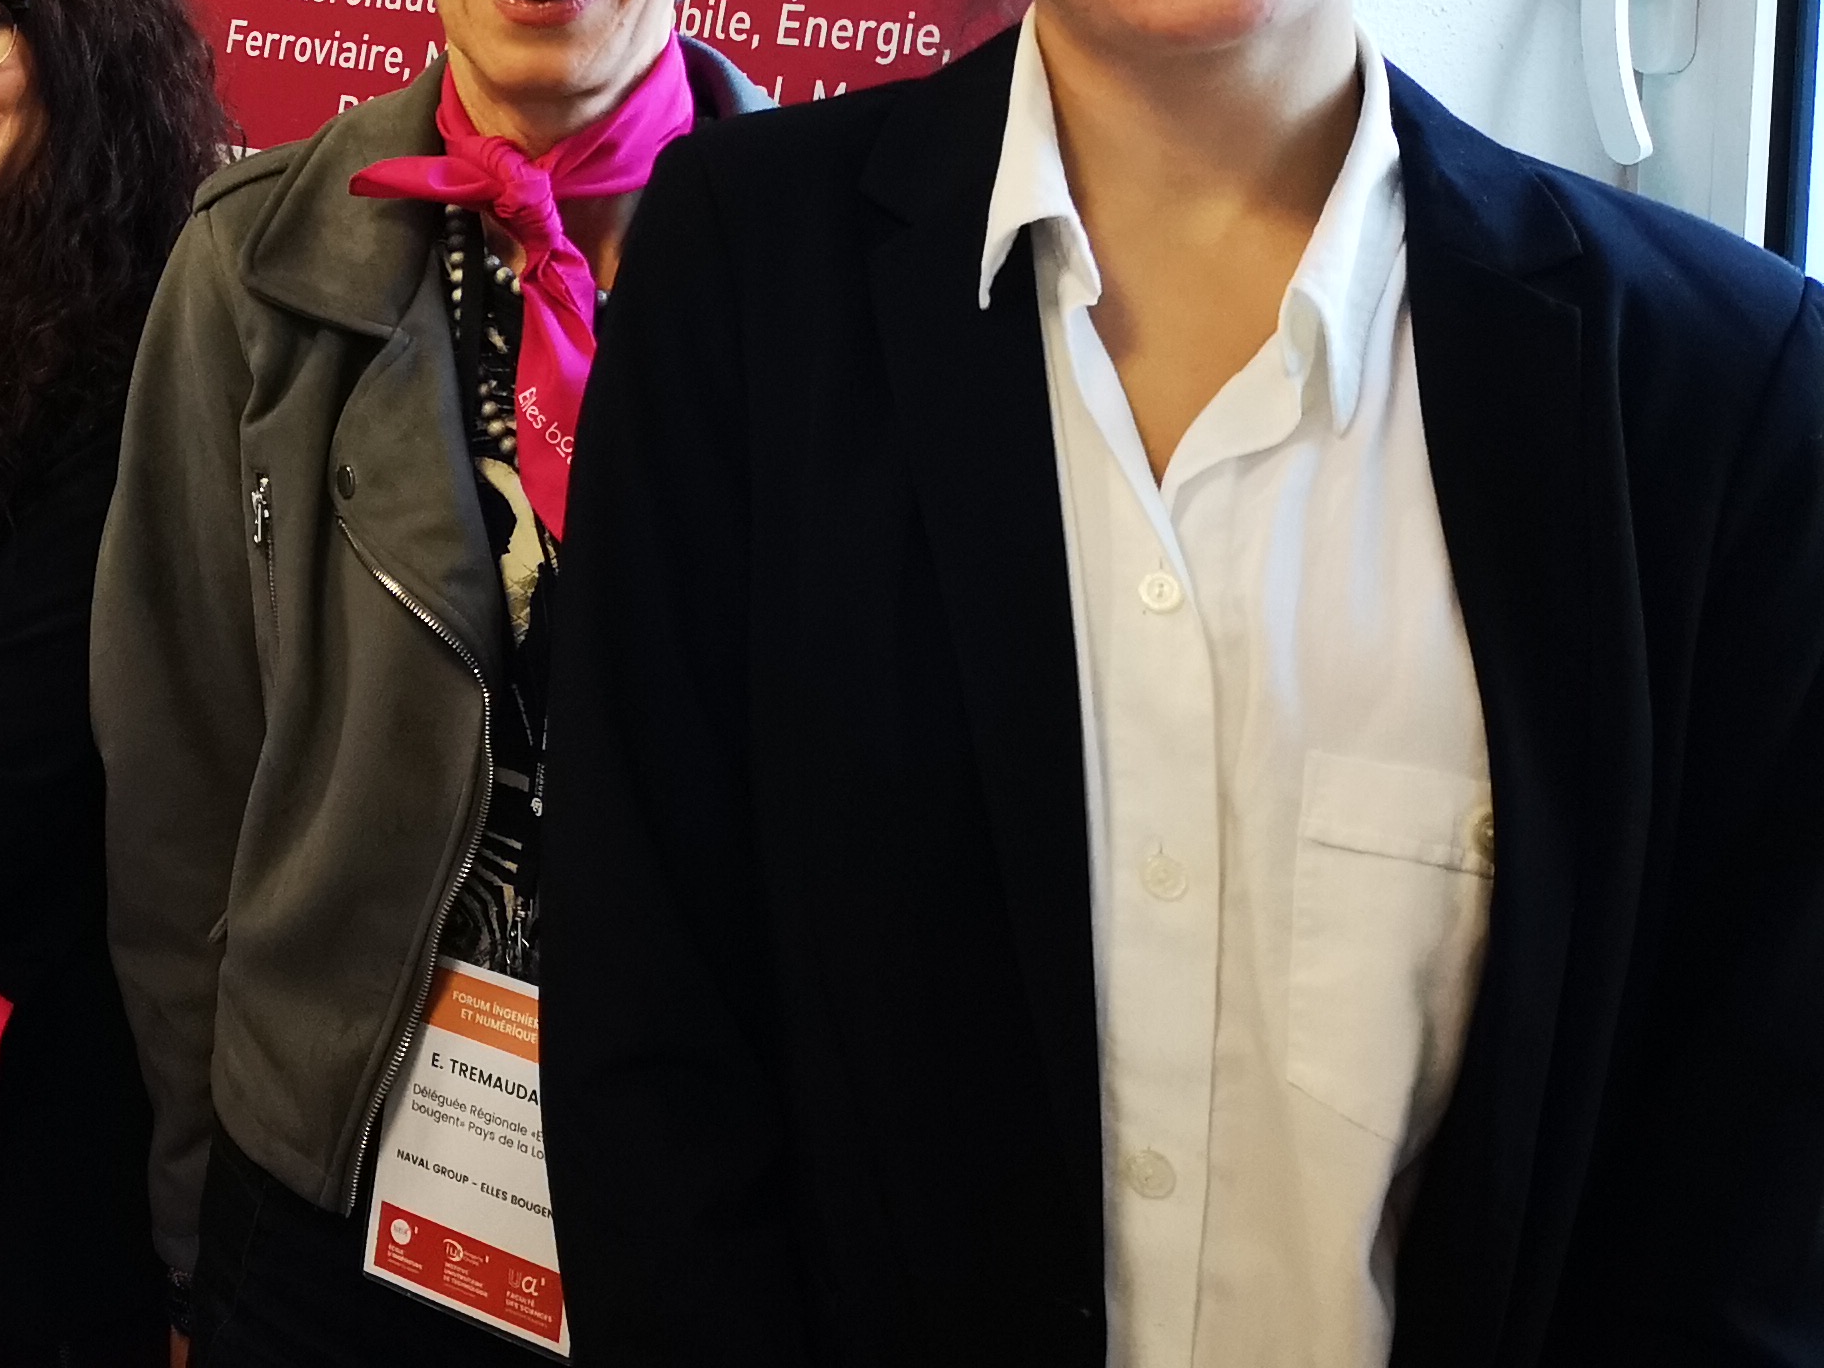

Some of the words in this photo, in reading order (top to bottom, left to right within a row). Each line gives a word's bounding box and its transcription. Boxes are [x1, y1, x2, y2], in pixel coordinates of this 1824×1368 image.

[226, 18, 412, 82] Ferroviaire,
[518, 386, 548, 430] Elles
[452, 990, 491, 1013] FORUM
[460, 1008, 473, 1021] ET
[431, 1052, 444, 1070] E.
[412, 1082, 467, 1113] Déléguée
[469, 1104, 528, 1137] Régionale
[468, 1120, 495, 1142] Pays
[498, 1134, 514, 1148] de
[517, 1139, 528, 1154] la
[396, 1148, 431, 1171] NAVAL
[432, 1163, 469, 1185] GROUP
[480, 1182, 508, 1202] ELLES
